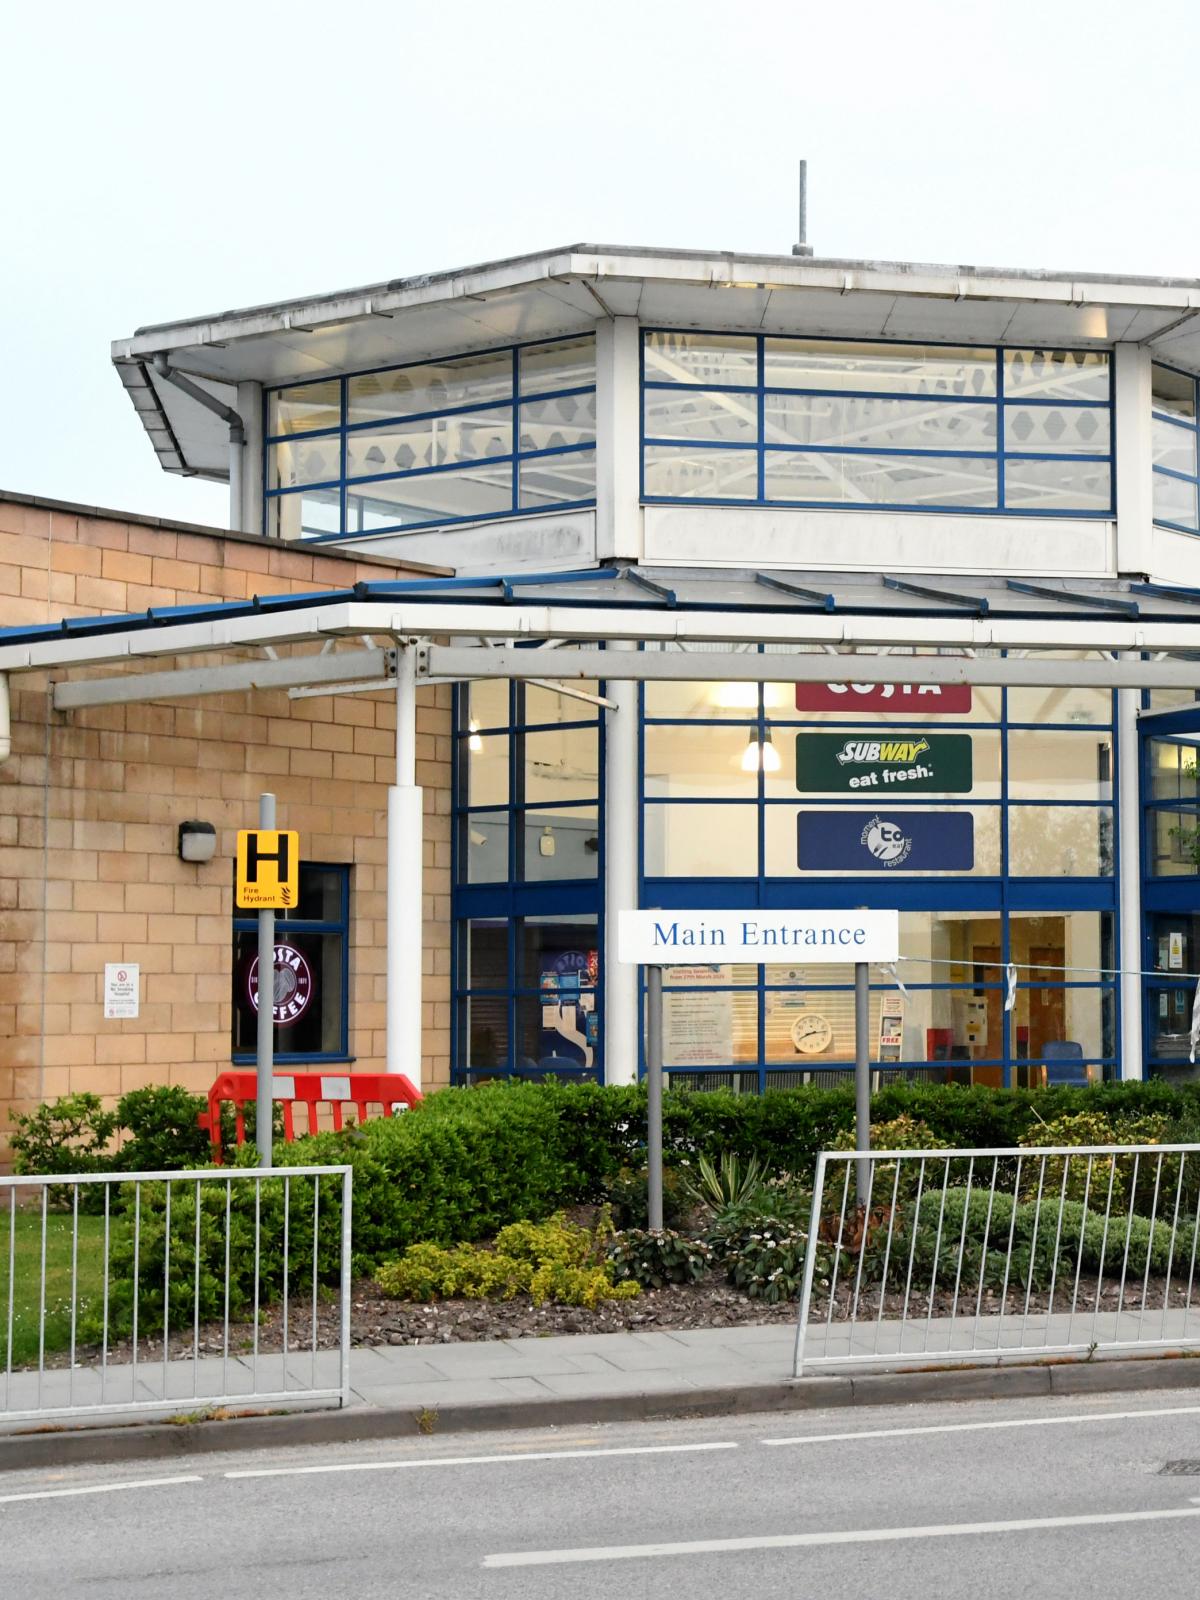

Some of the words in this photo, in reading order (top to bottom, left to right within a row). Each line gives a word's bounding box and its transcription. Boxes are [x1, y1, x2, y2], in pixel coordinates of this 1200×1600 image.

[839, 738, 930, 765] SUBWAY
[849, 772, 879, 788] eat
[861, 814, 881, 845] moment
[881, 827, 903, 842] to
[247, 834, 288, 883] H
[883, 838, 912, 868] restaurant
[243, 895, 275, 903] Hydrant
[652, 922, 727, 946] Main
[740, 922, 867, 946] Entrance
